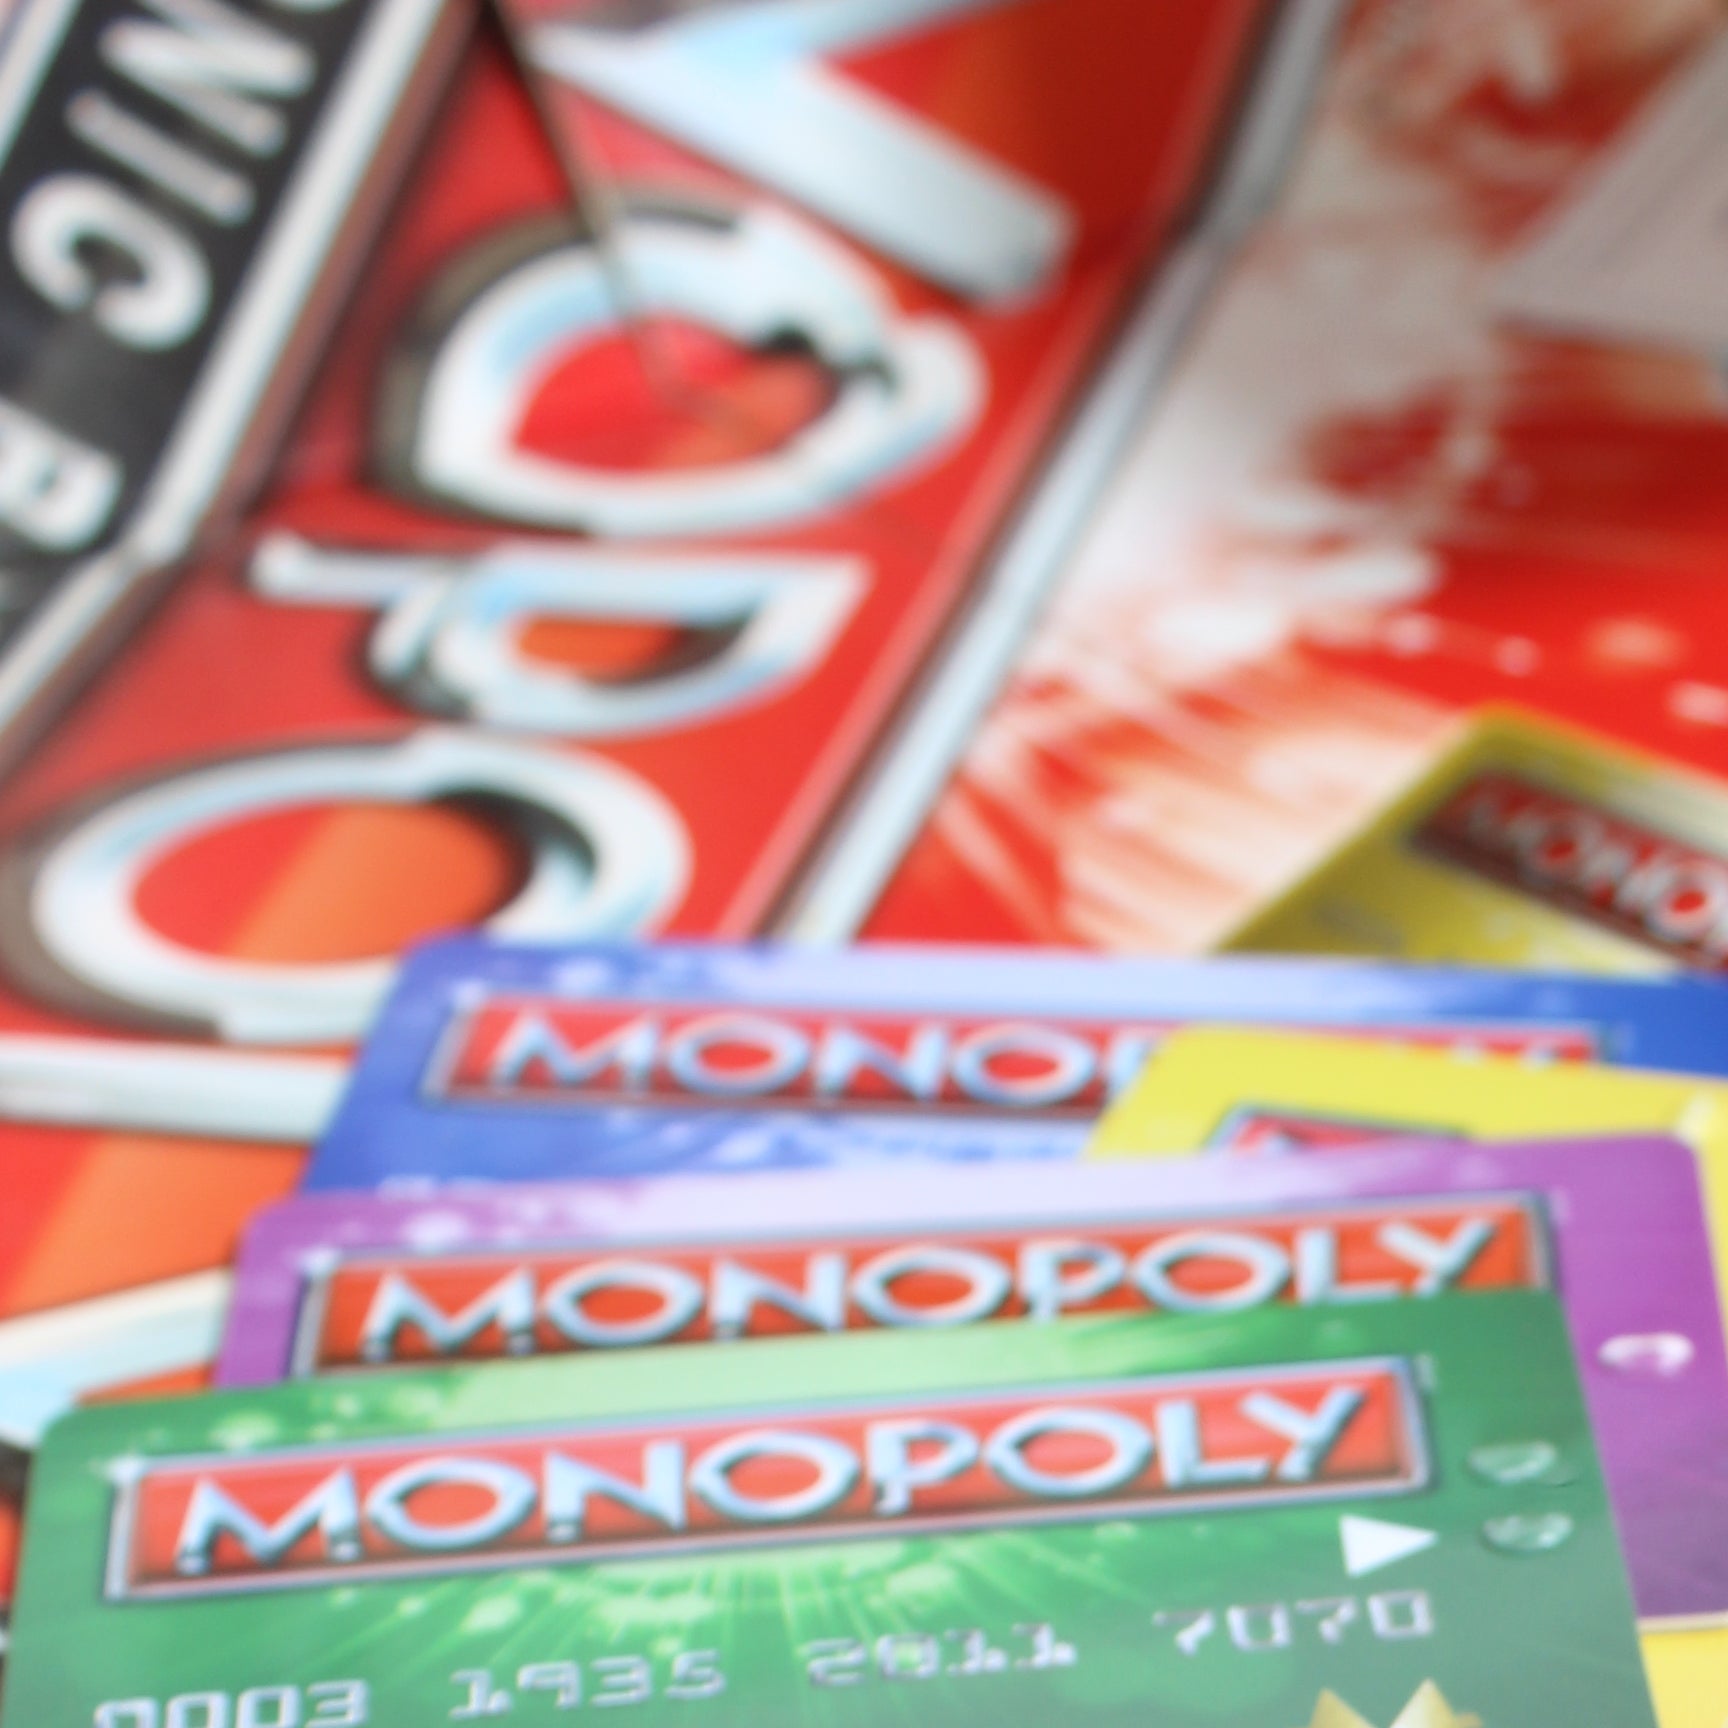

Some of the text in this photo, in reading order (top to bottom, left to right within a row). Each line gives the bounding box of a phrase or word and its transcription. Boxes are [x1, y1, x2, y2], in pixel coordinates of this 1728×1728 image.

[364, 1218, 1500, 1362] MONOPOLY
[176, 1384, 1368, 1574] MONOPOLY
[450, 1650, 725, 1721] 1935
[801, 1620, 1077, 1688] 2011
[1153, 1590, 1436, 1655] 7070
